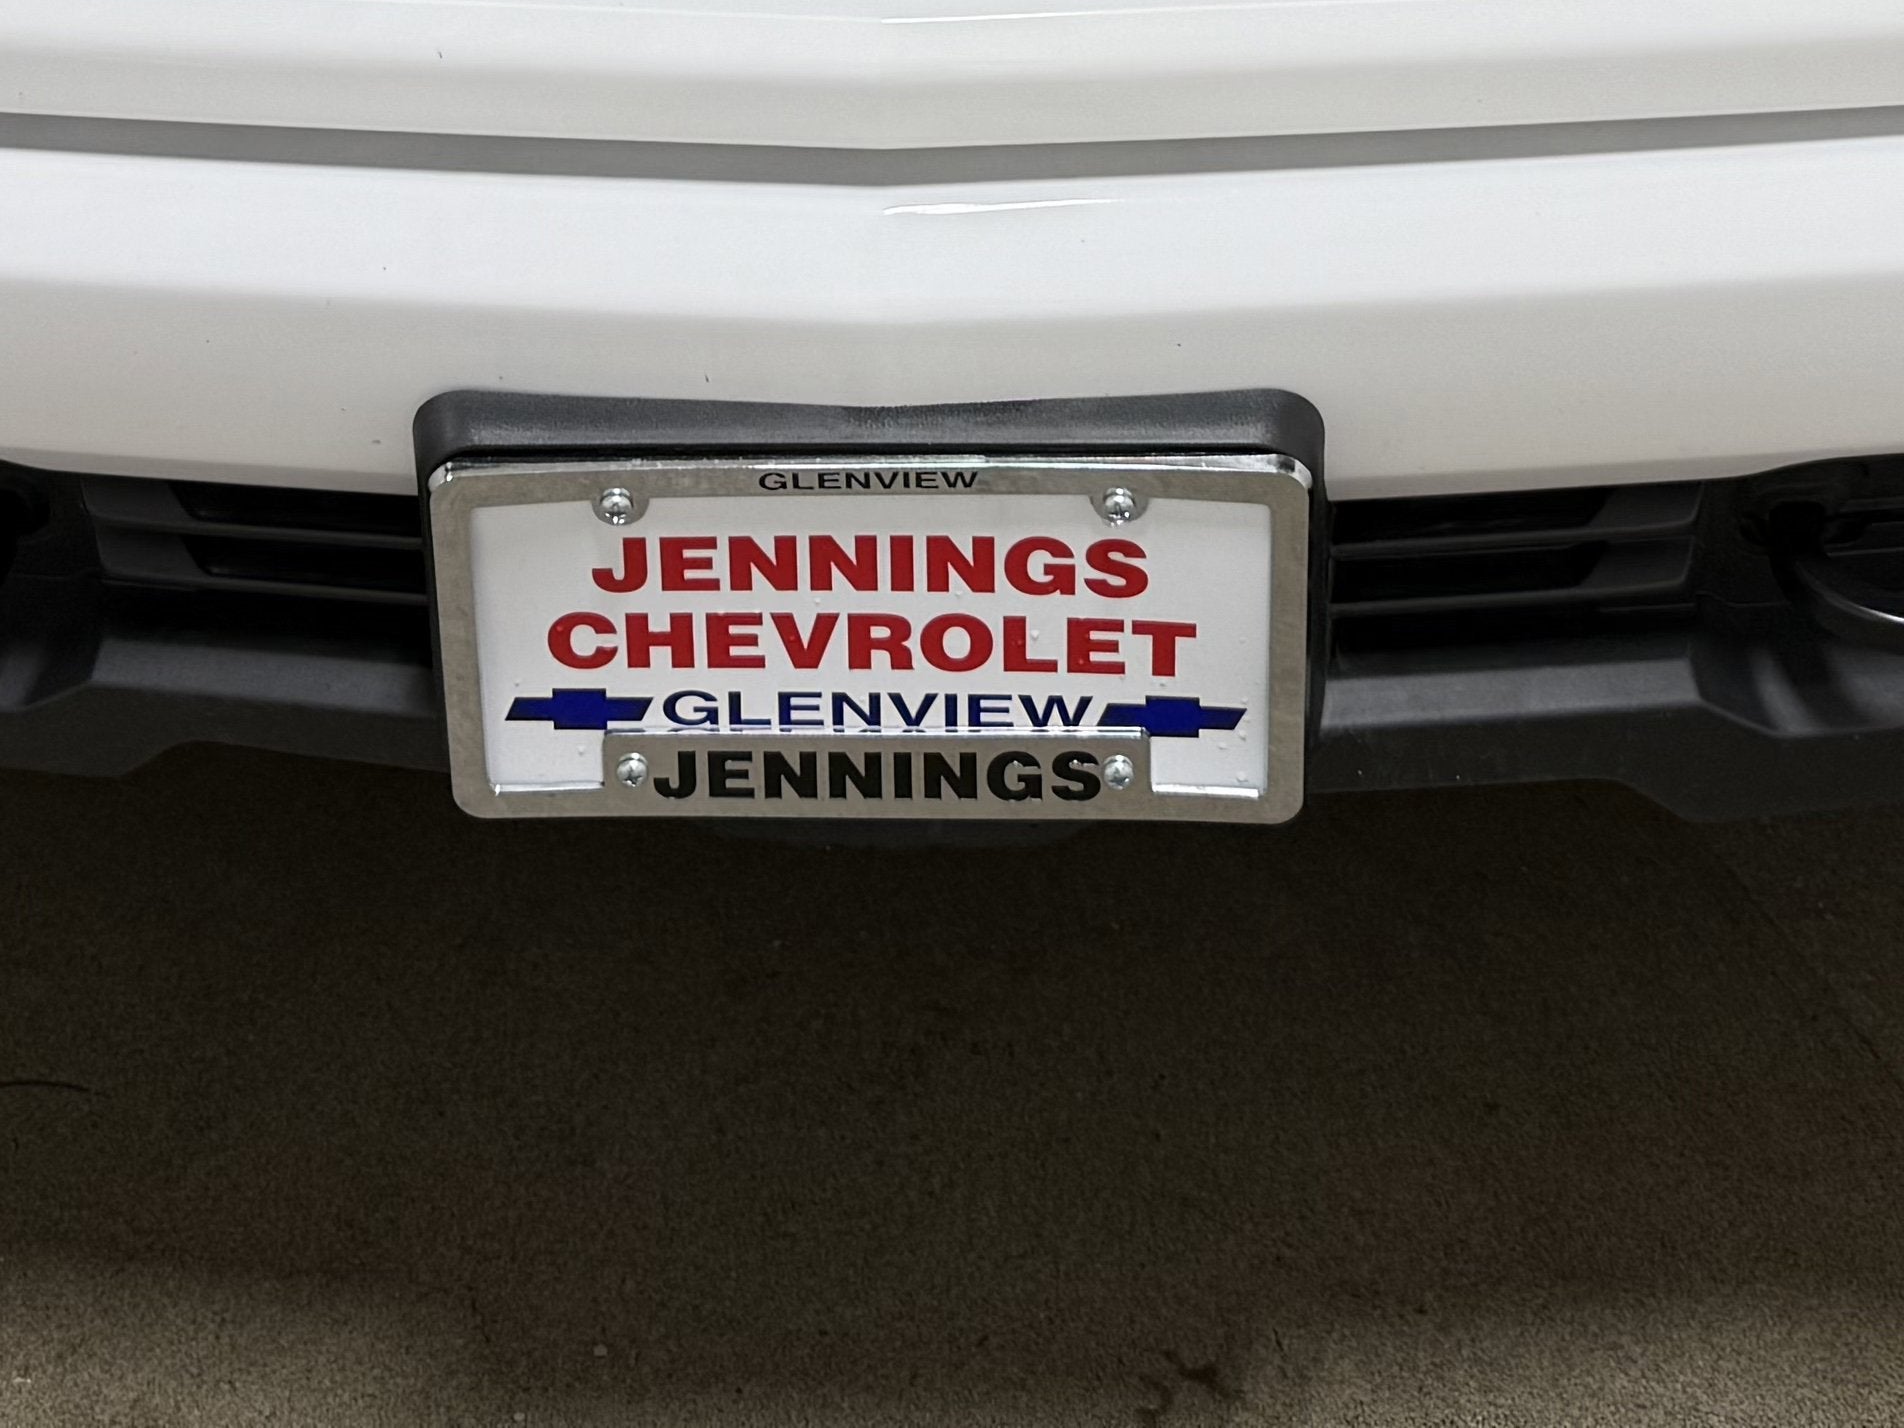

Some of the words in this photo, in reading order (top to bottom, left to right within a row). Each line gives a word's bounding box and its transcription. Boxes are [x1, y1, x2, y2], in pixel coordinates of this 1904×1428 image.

[757, 470, 980, 491] GLENVIEW
[591, 535, 1149, 598] JENNINGS
[547, 611, 1197, 678] CHEVROLET
[662, 690, 1093, 727] GLENVIEW
[653, 750, 1101, 801] JENNINGS
